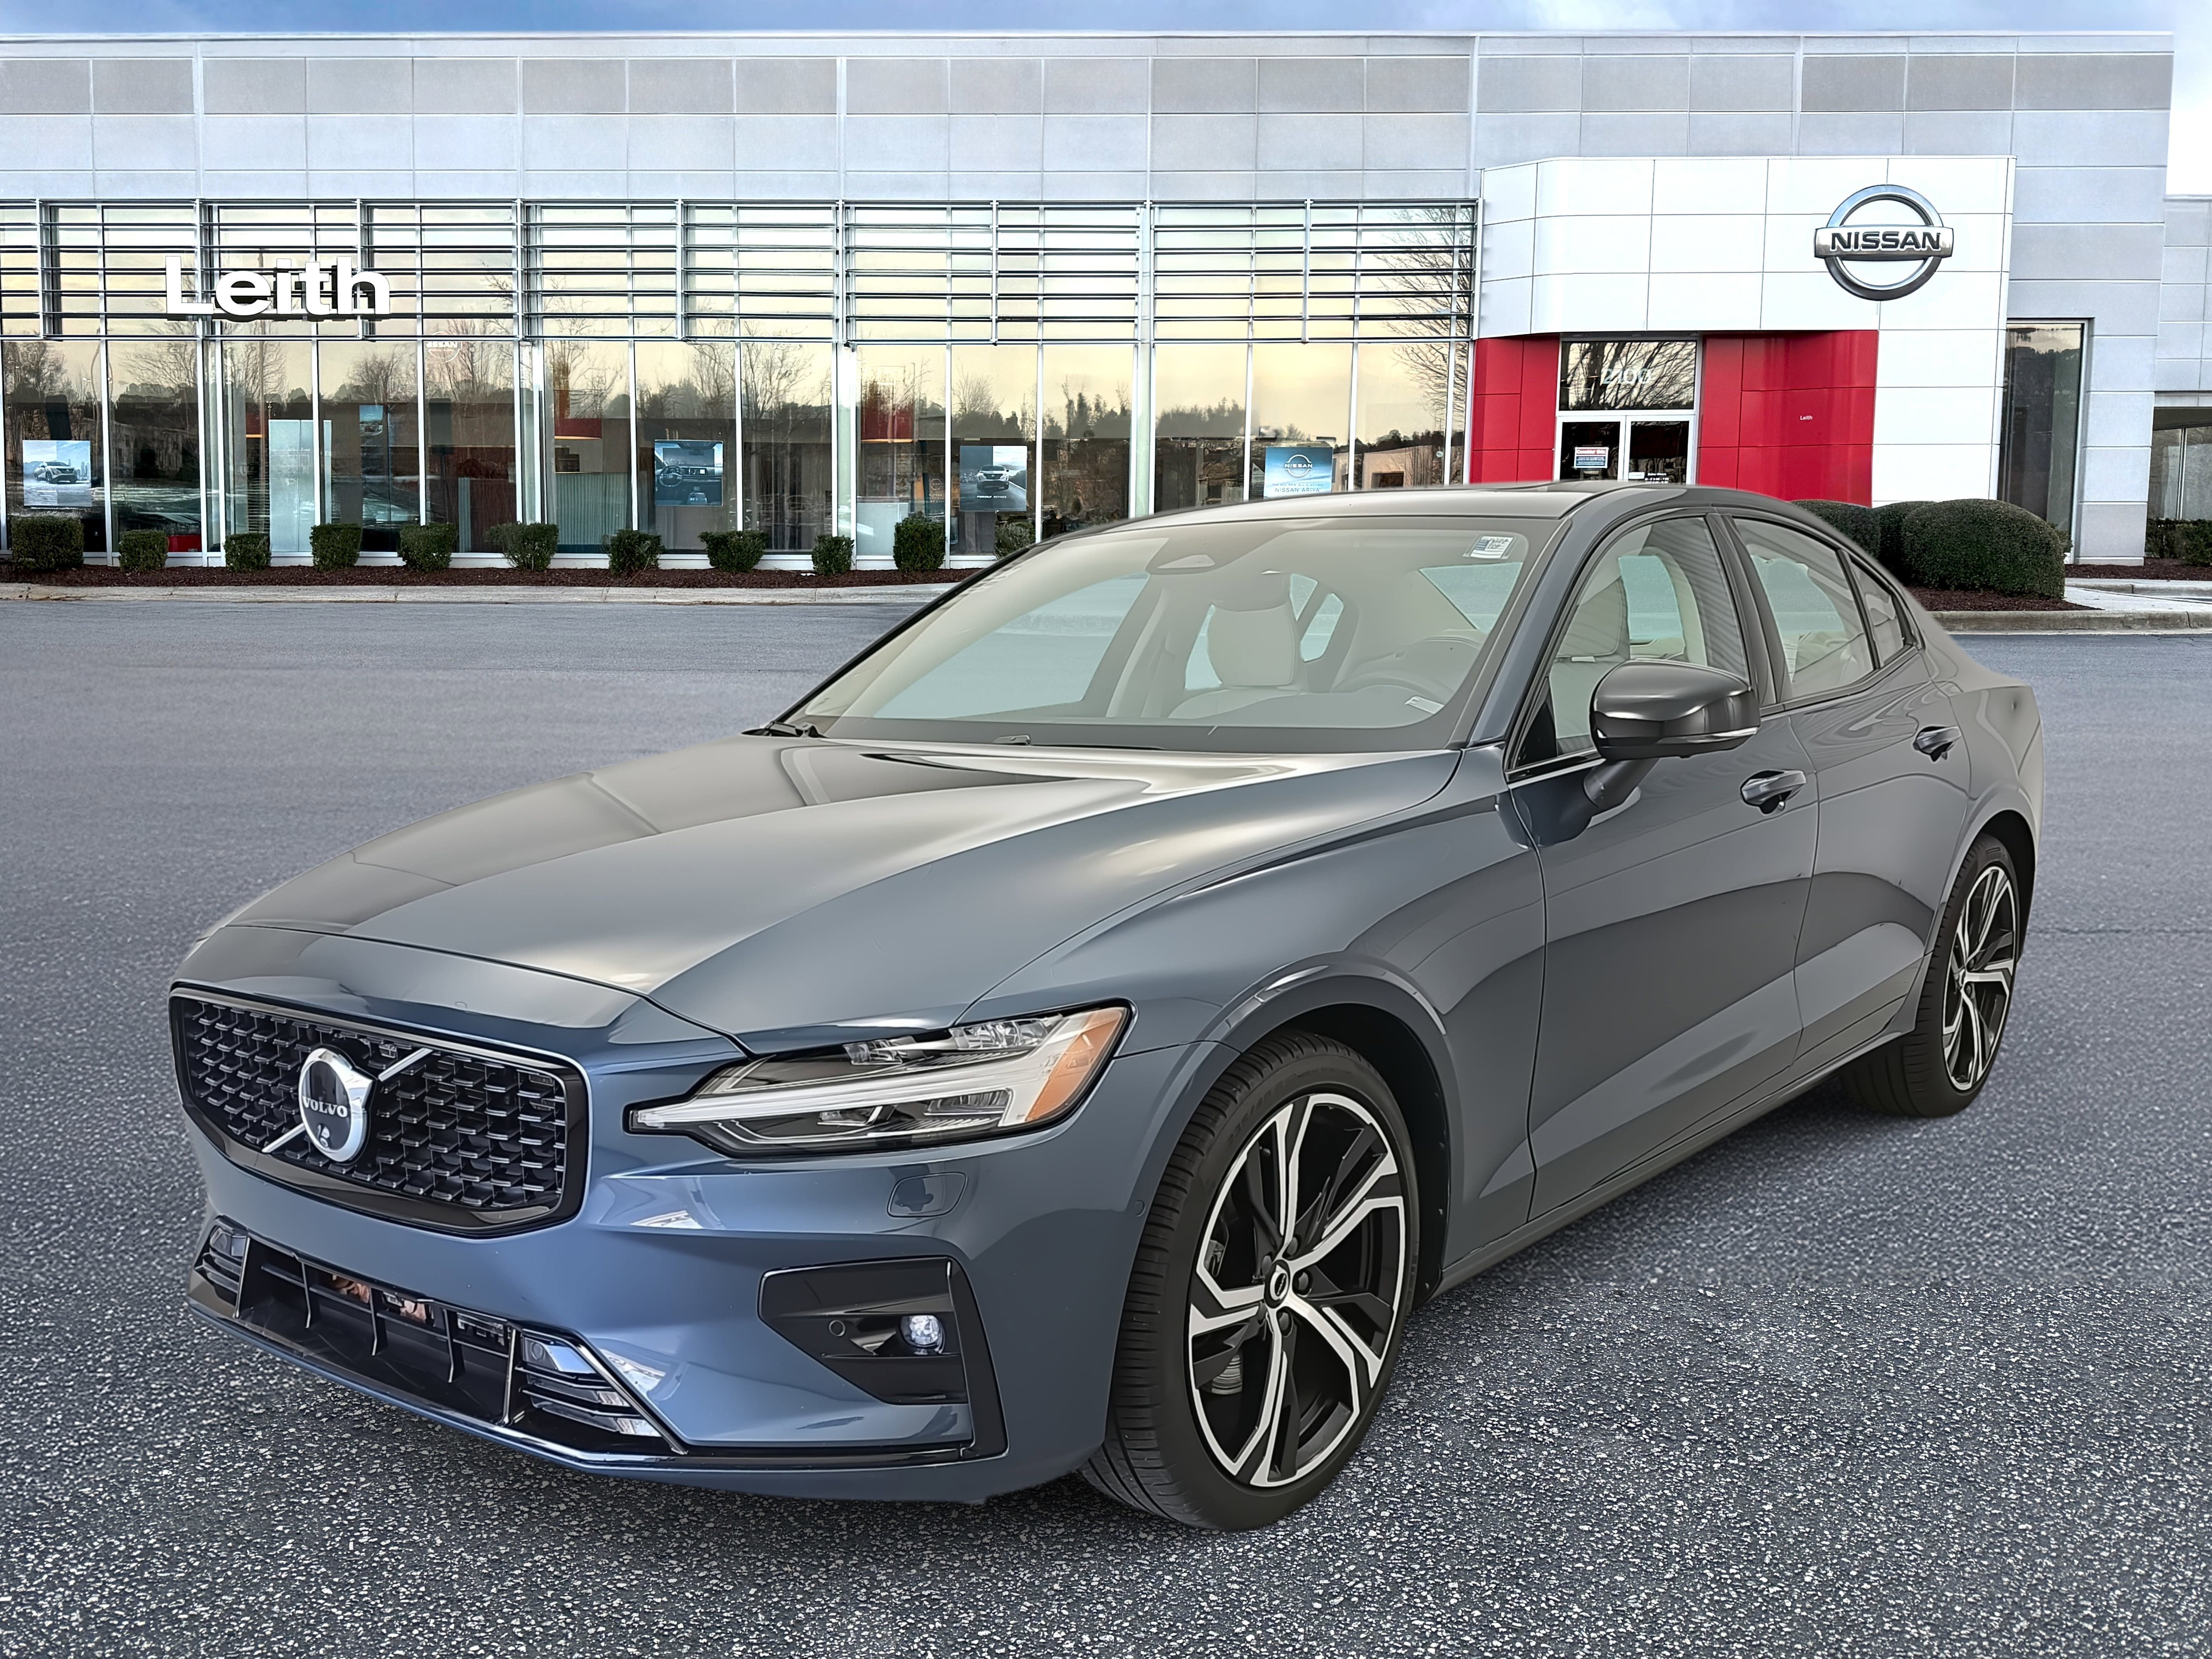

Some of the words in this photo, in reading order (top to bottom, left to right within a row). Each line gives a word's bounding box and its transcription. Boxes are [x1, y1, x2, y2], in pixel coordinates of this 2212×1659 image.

[1831, 232, 1941, 251] NISSAN
[165, 256, 390, 316] Leith
[302, 1096, 348, 1117] VOLVO
